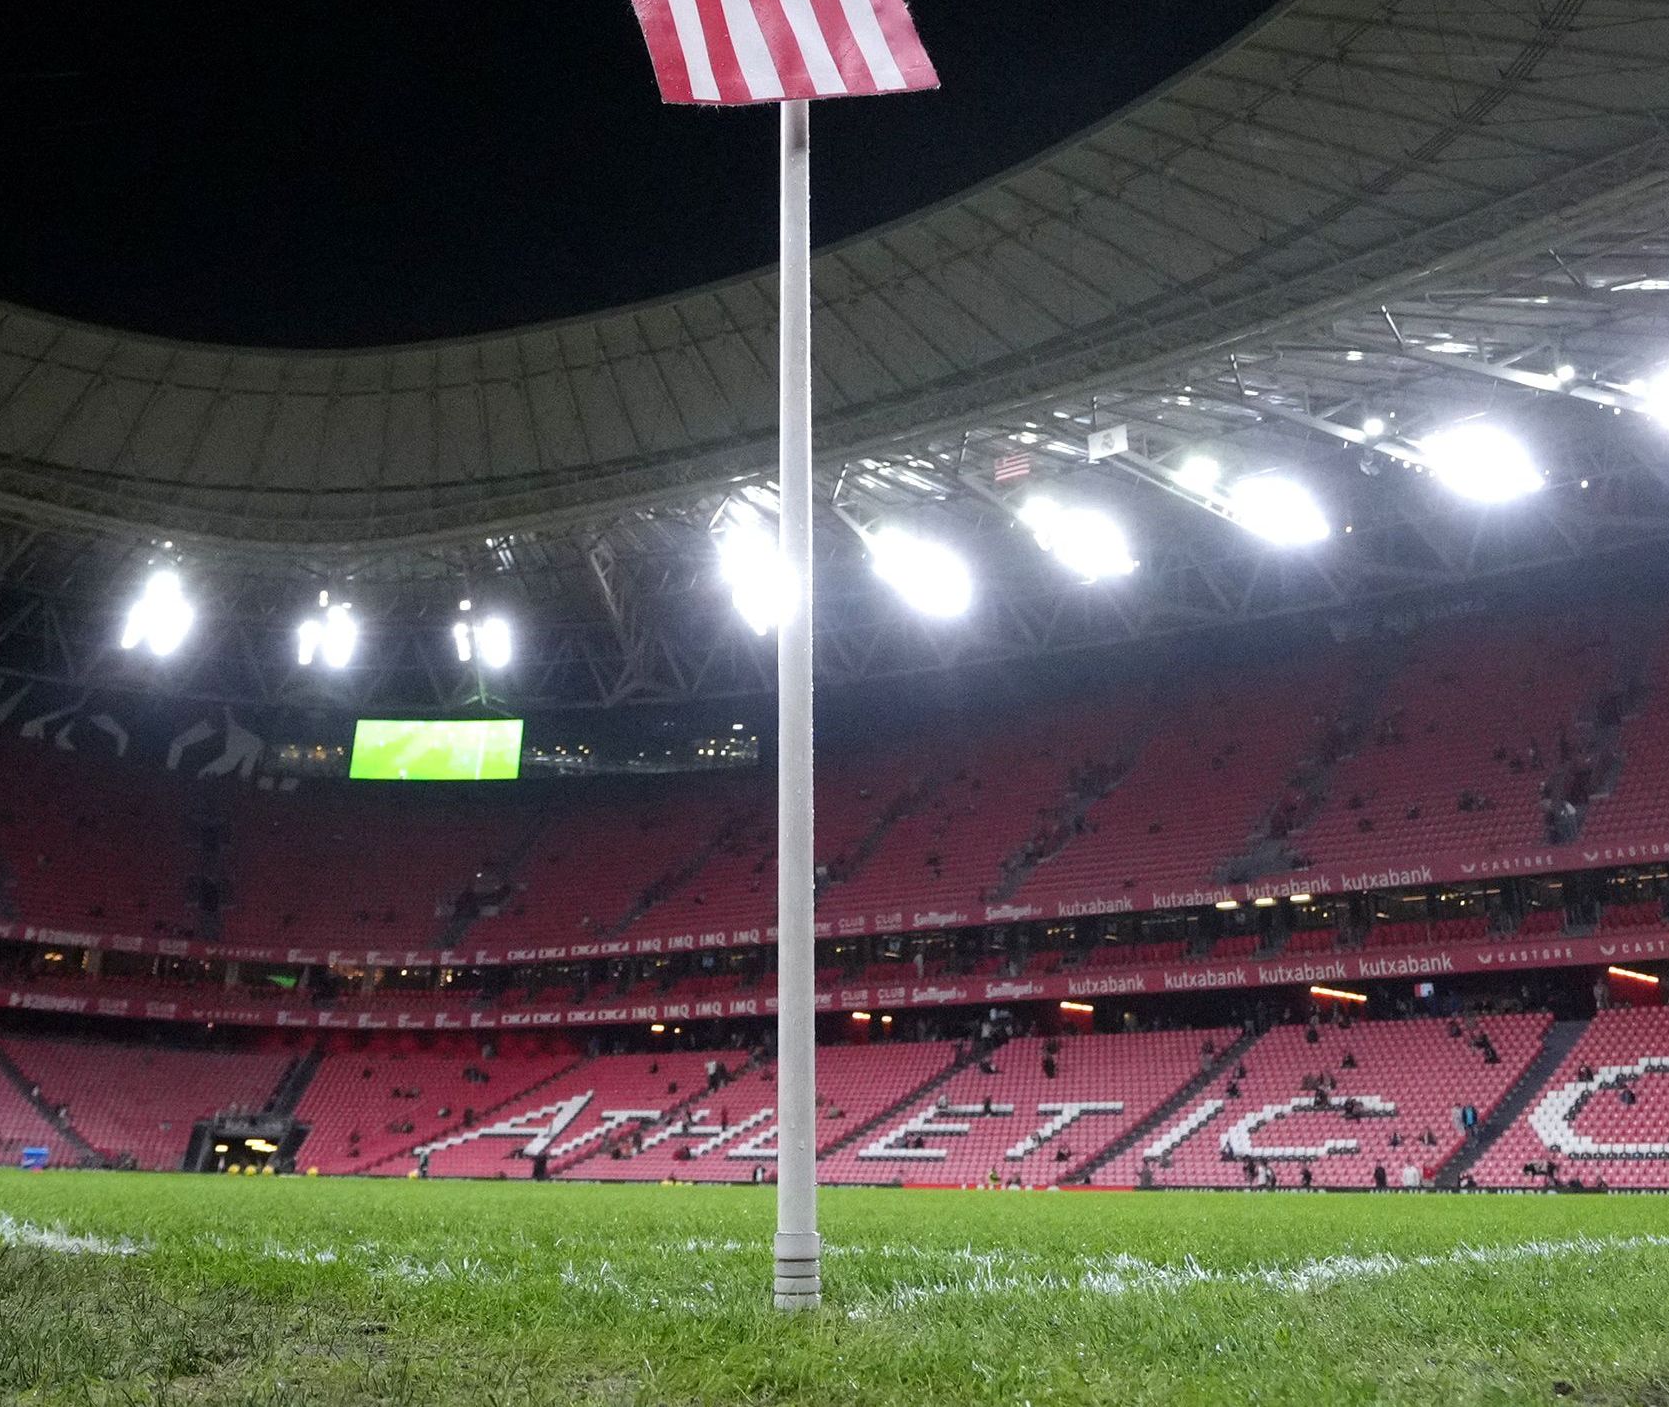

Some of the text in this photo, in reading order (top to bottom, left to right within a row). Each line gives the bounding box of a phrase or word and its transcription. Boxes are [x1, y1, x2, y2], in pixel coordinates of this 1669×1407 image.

[1480, 854, 1554, 873] CASTORE
[1246, 875, 1331, 900] kutxabank
[1341, 866, 1433, 891] kutxabank
[1058, 896, 1133, 917] kutxabank
[1153, 888, 1231, 910] kutxabank
[1359, 953, 1454, 979] kutxabank
[1497, 947, 1573, 963] CASTORE
[1164, 967, 1246, 989] kutxabank
[1259, 960, 1346, 984] kutxabank
[1069, 974, 1145, 995] kutxabank
